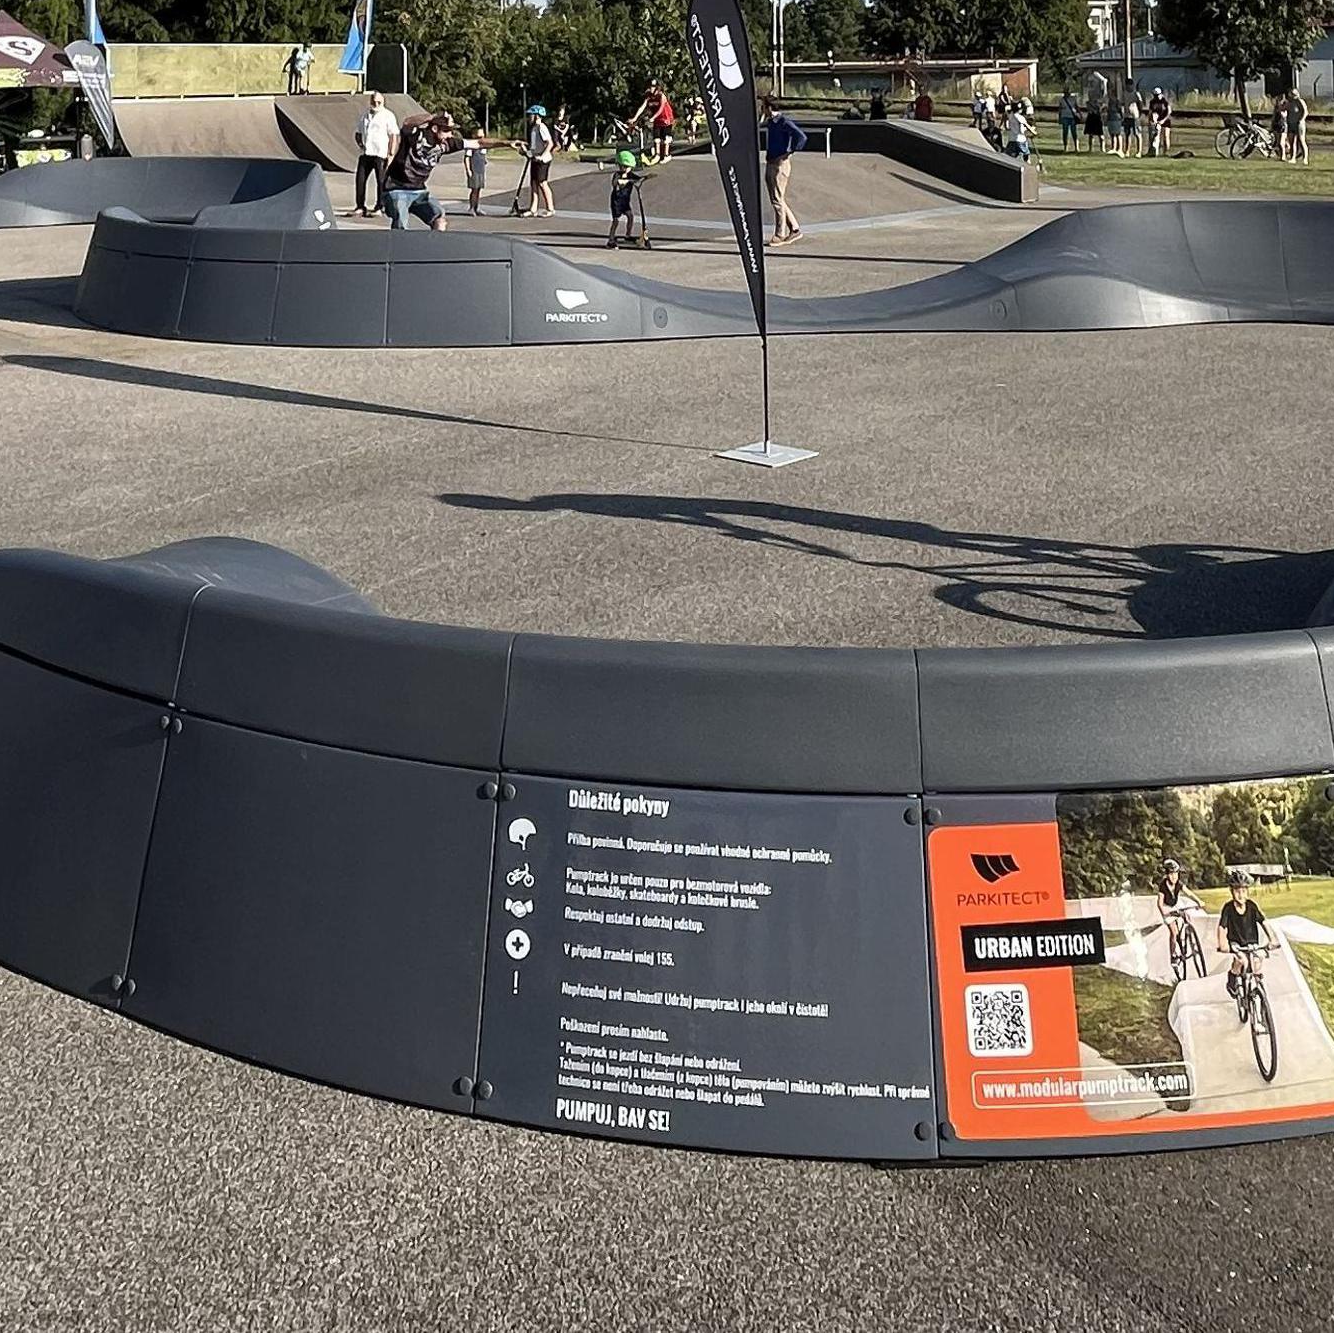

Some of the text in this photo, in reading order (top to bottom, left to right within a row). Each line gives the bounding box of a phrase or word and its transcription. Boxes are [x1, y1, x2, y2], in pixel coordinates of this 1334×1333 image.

[568, 789, 670, 817] Důležité pokyny
[564, 943, 570, 955] V
[657, 951, 675, 966] 155.
[974, 933, 1095, 960] URBAN EDITION
[983, 1071, 1188, 1099] www.modularpumptrack.com
[556, 1098, 670, 1131] PUMPUJ, BAV SE!
